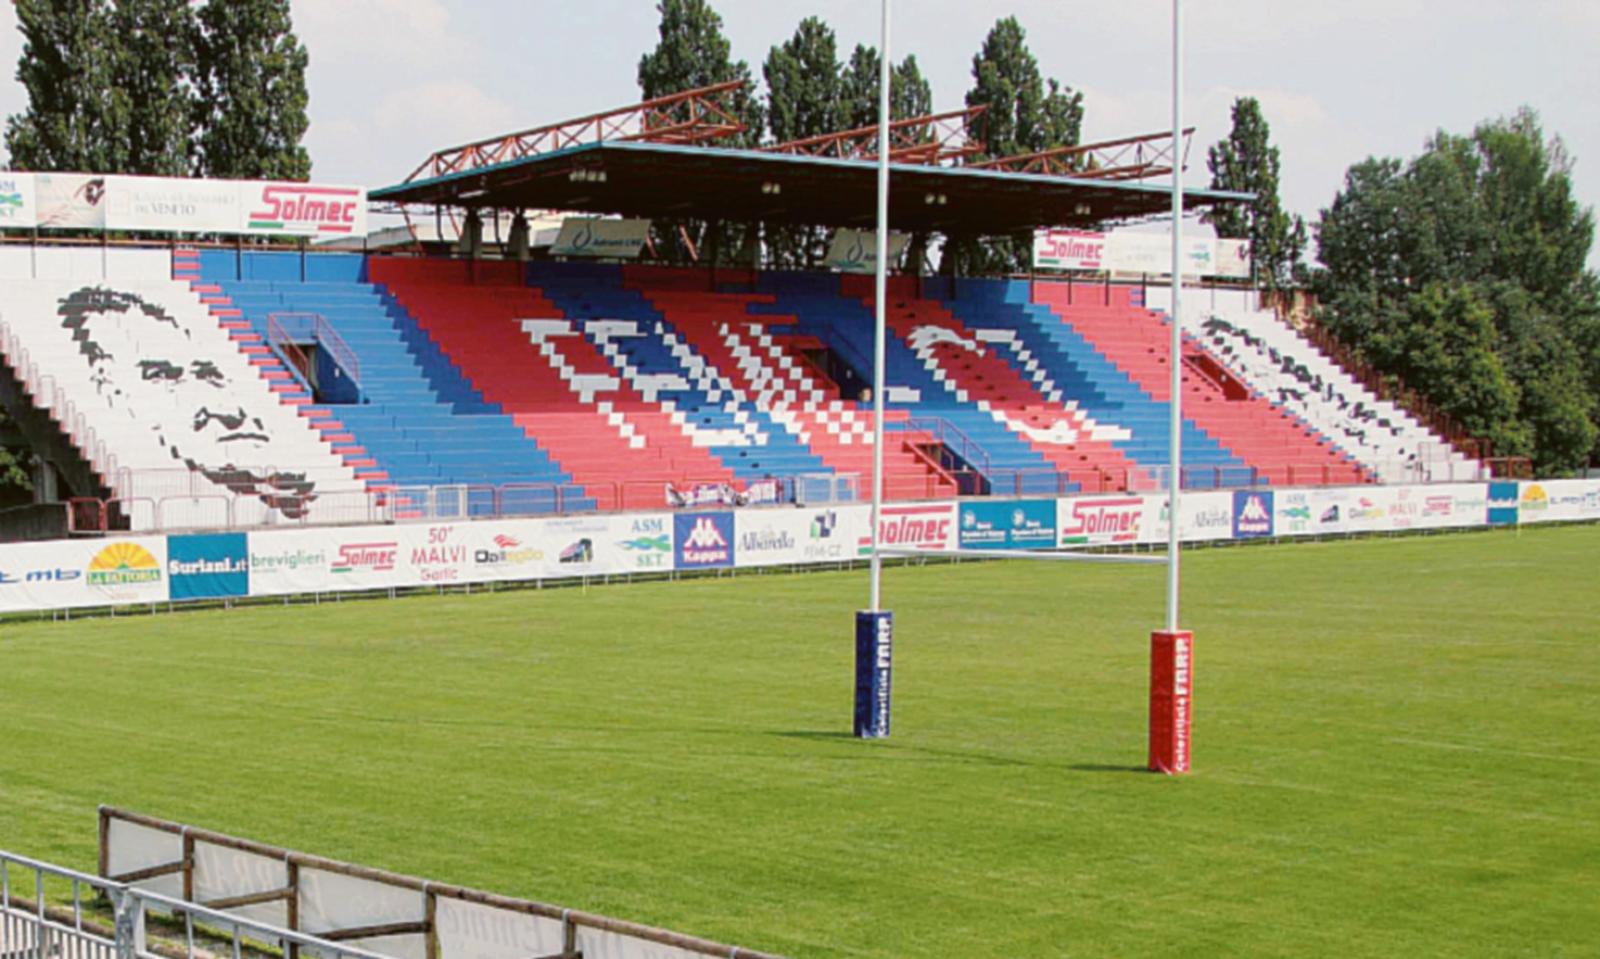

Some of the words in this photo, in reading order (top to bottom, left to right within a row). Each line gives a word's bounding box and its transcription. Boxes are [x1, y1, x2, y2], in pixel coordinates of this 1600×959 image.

[249, 186, 360, 223] Solmec
[1039, 230, 1104, 259] Solmec
[632, 518, 662, 532] ASM
[1063, 498, 1143, 534] Solmec
[251, 549, 326, 569] breviglieri
[332, 543, 398, 566] Solmec
[411, 545, 466, 565] MALVI
[683, 550, 728, 563] Kappa
